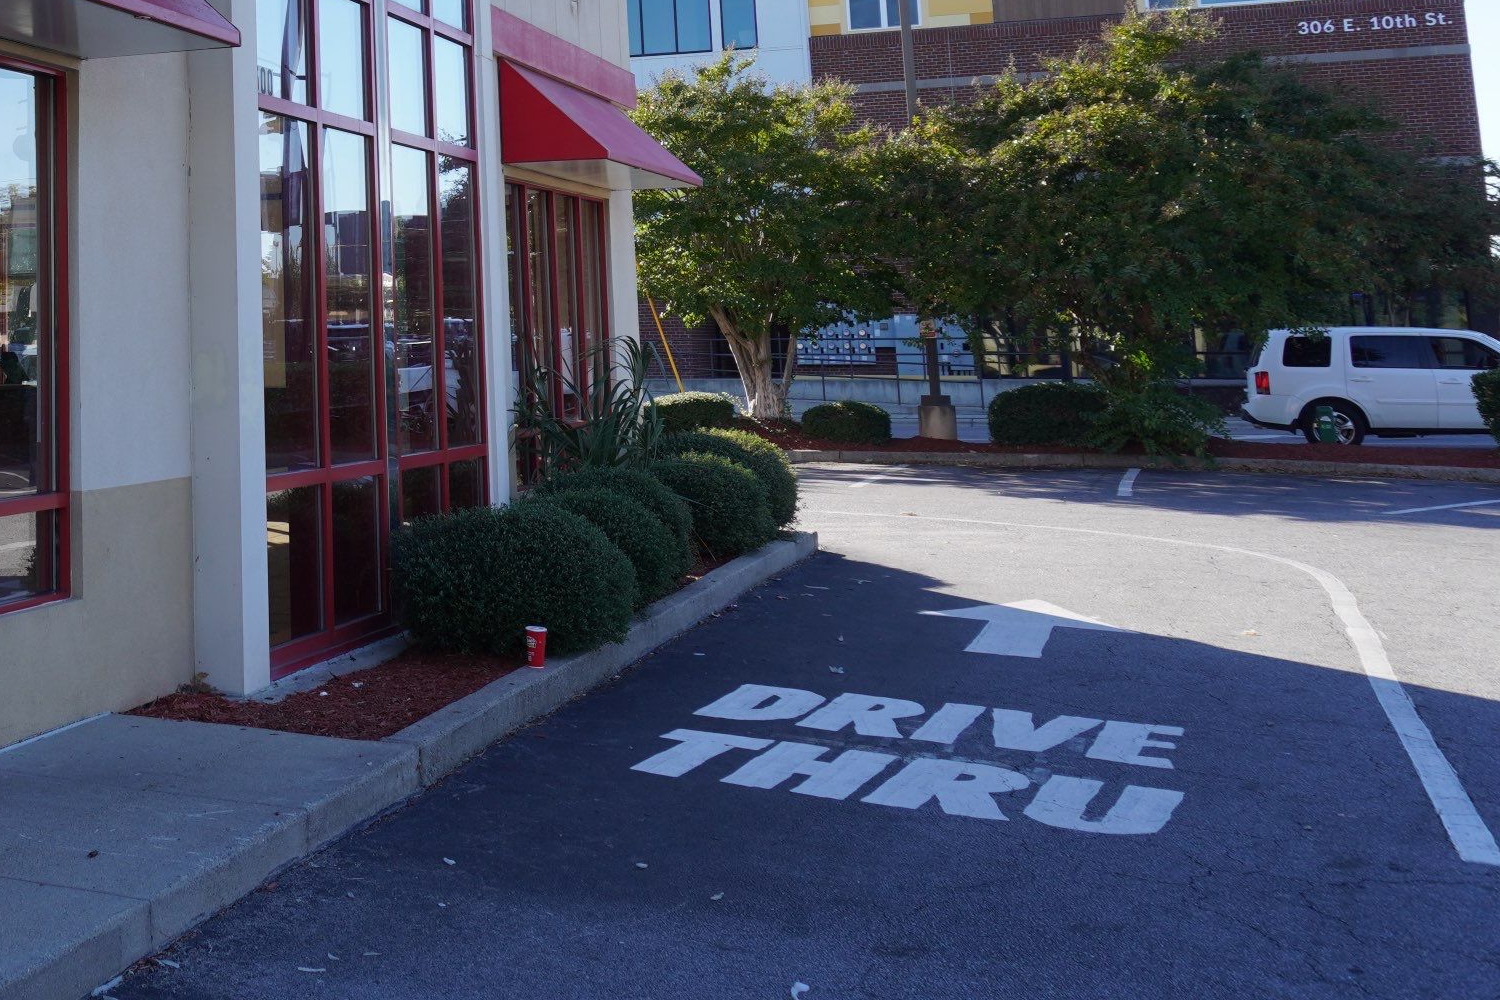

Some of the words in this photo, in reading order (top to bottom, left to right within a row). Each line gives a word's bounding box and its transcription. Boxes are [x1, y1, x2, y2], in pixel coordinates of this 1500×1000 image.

[1297, 19, 1335, 35] 306
[1343, 18, 1361, 32] E.
[1369, 13, 1416, 31] 10th
[1425, 12, 1453, 26] St.
[693, 684, 1184, 769] DRIVE
[629, 728, 1184, 834] THRU
